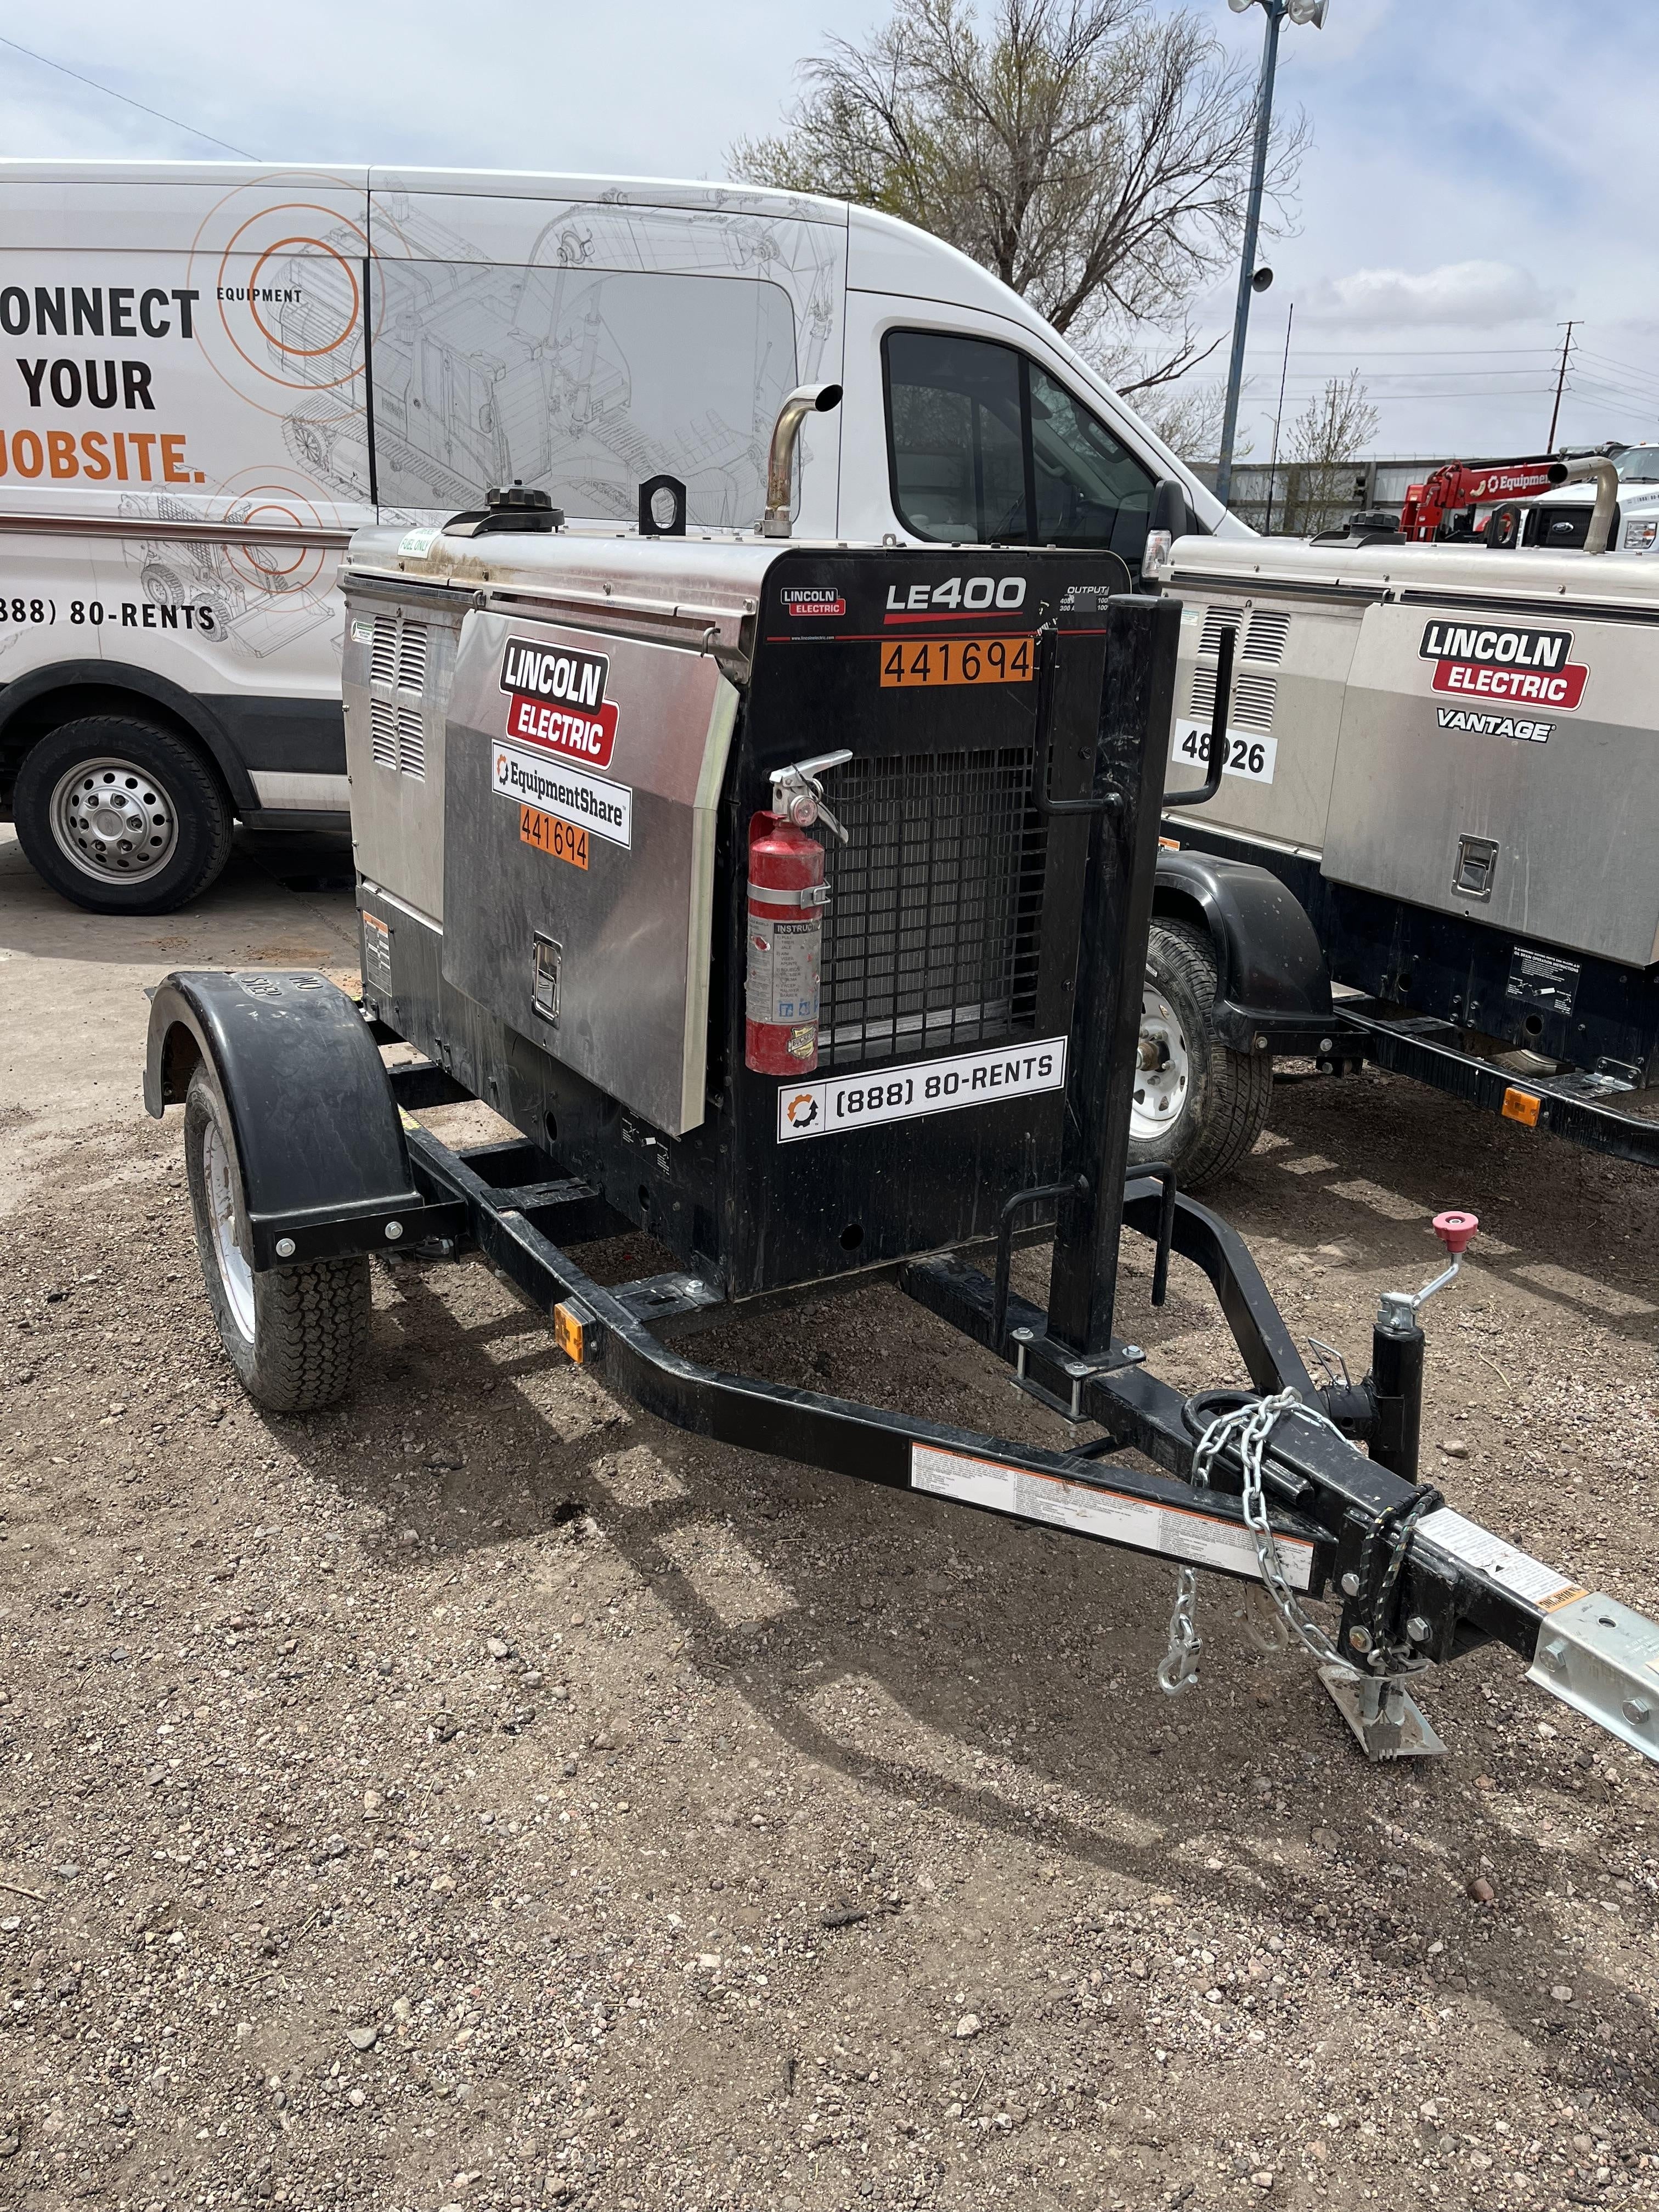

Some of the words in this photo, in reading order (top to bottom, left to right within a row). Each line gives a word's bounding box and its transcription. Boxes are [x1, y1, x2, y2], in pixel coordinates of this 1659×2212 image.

[0, 286, 199, 338] ONNECT
[217, 287, 301, 302] EQUIPMENT
[16, 359, 156, 410] YOUR
[400, 538, 414, 550] FUEL
[414, 539, 430, 551] ONLY
[784, 591, 834, 602] LINCOLN
[796, 604, 840, 613] ELECTRIC
[886, 577, 1026, 610] LE400
[70, 601, 215, 630] 80-RENTS
[884, 641, 1029, 682] 441694
[1426, 626, 1563, 667] LINCOLN
[505, 647, 601, 707] LINCOLN
[1448, 666, 1567, 701] ELECTRIC
[517, 703, 603, 755] ELECTRIC
[1437, 708, 1552, 742] VANTAGE
[511, 761, 622, 827] EquipmentShare
[522, 809, 586, 866] 441694
[1532, 956, 1553, 965] OPERATION
[1553, 962, 1579, 973] INSTRUCTIONS
[240, 978, 283, 996] STEP
[837, 1079, 915, 1118] (888)
[925, 1054, 1053, 1099] 80-RENTS
